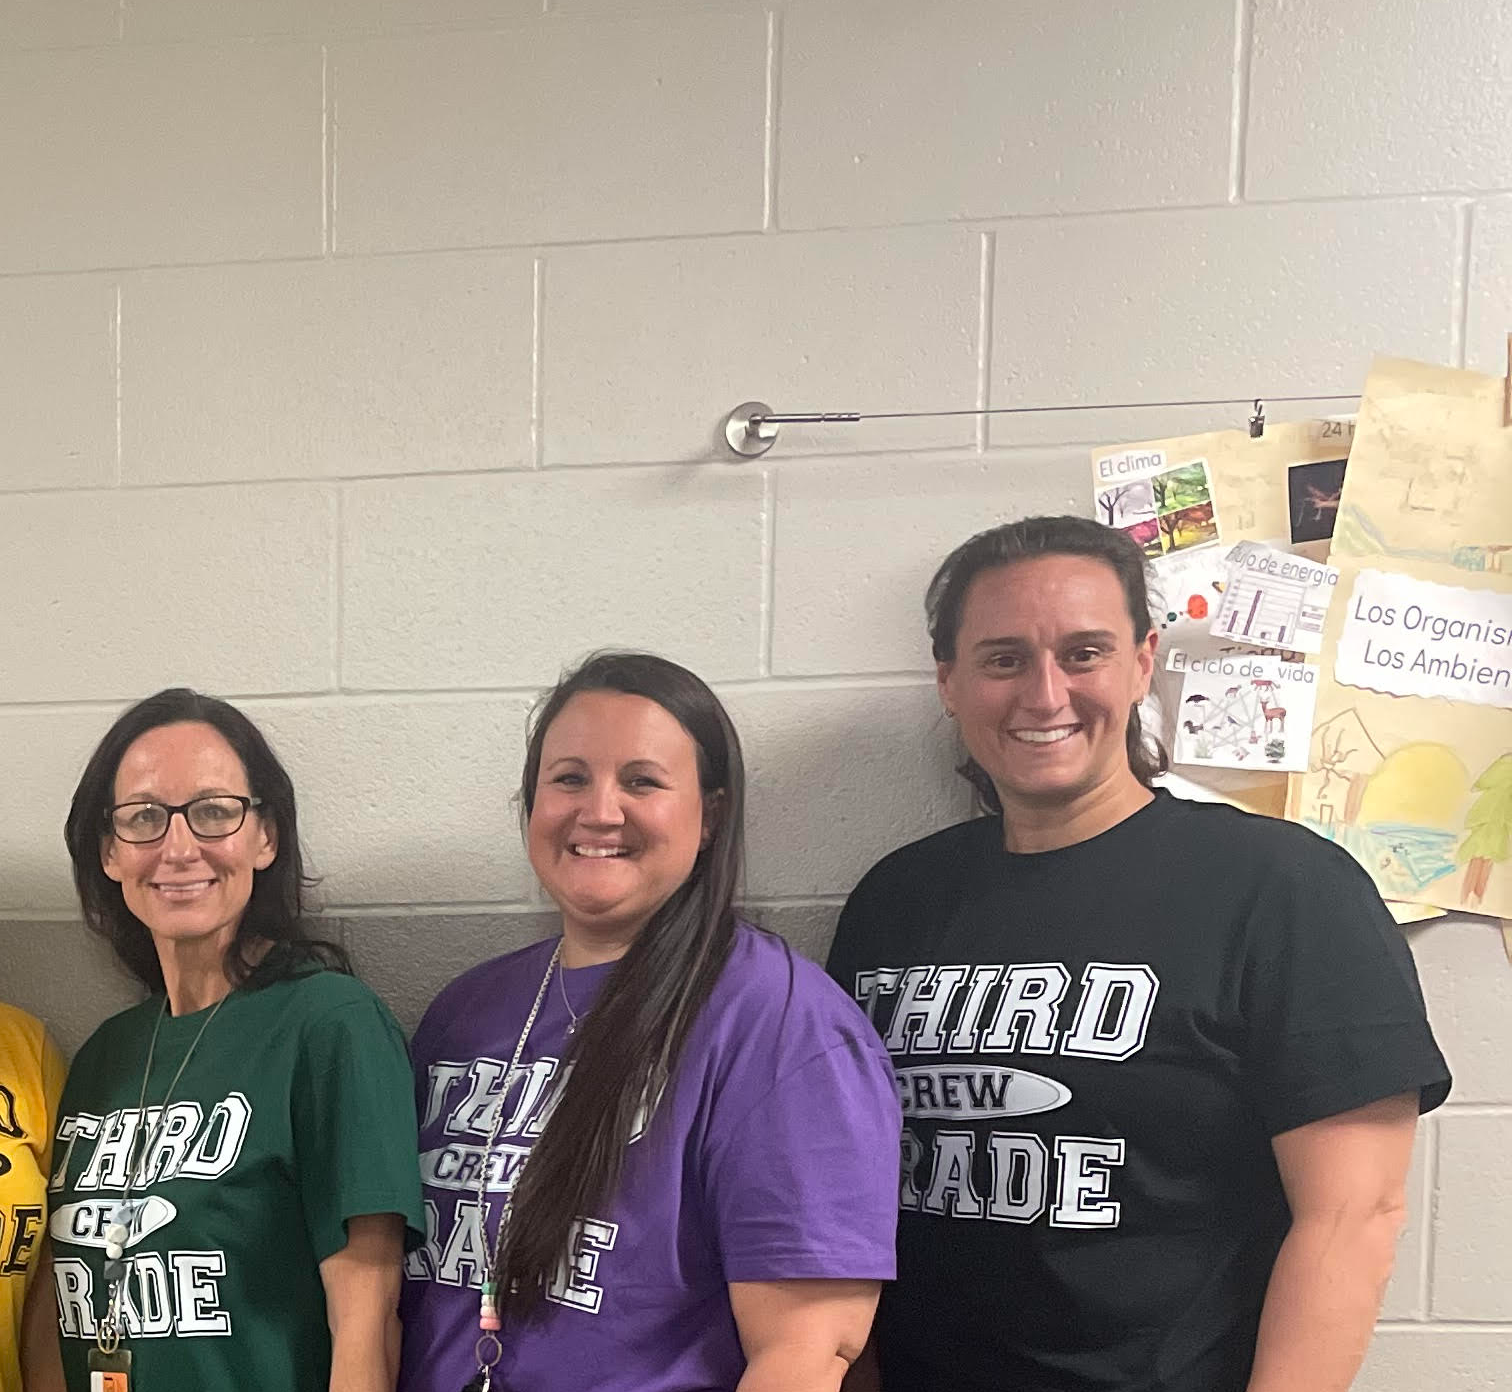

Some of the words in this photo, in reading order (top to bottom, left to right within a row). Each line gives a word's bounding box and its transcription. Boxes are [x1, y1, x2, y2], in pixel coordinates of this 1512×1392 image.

[1322, 420, 1342, 438] 24
[1099, 461, 1113, 478] El
[1117, 453, 1163, 474] clima
[1258, 554, 1279, 574] de
[1355, 595, 1396, 626] Los
[1173, 653, 1186, 670] El
[1191, 655, 1235, 676] ciclo
[1239, 661, 1264, 678] de
[1278, 663, 1315, 684] vida
[1364, 639, 1405, 669] Los
[855, 962, 1160, 1062] THIRD
[899, 1129, 1125, 1229] RADE
[53, 1250, 232, 1339] RADE
